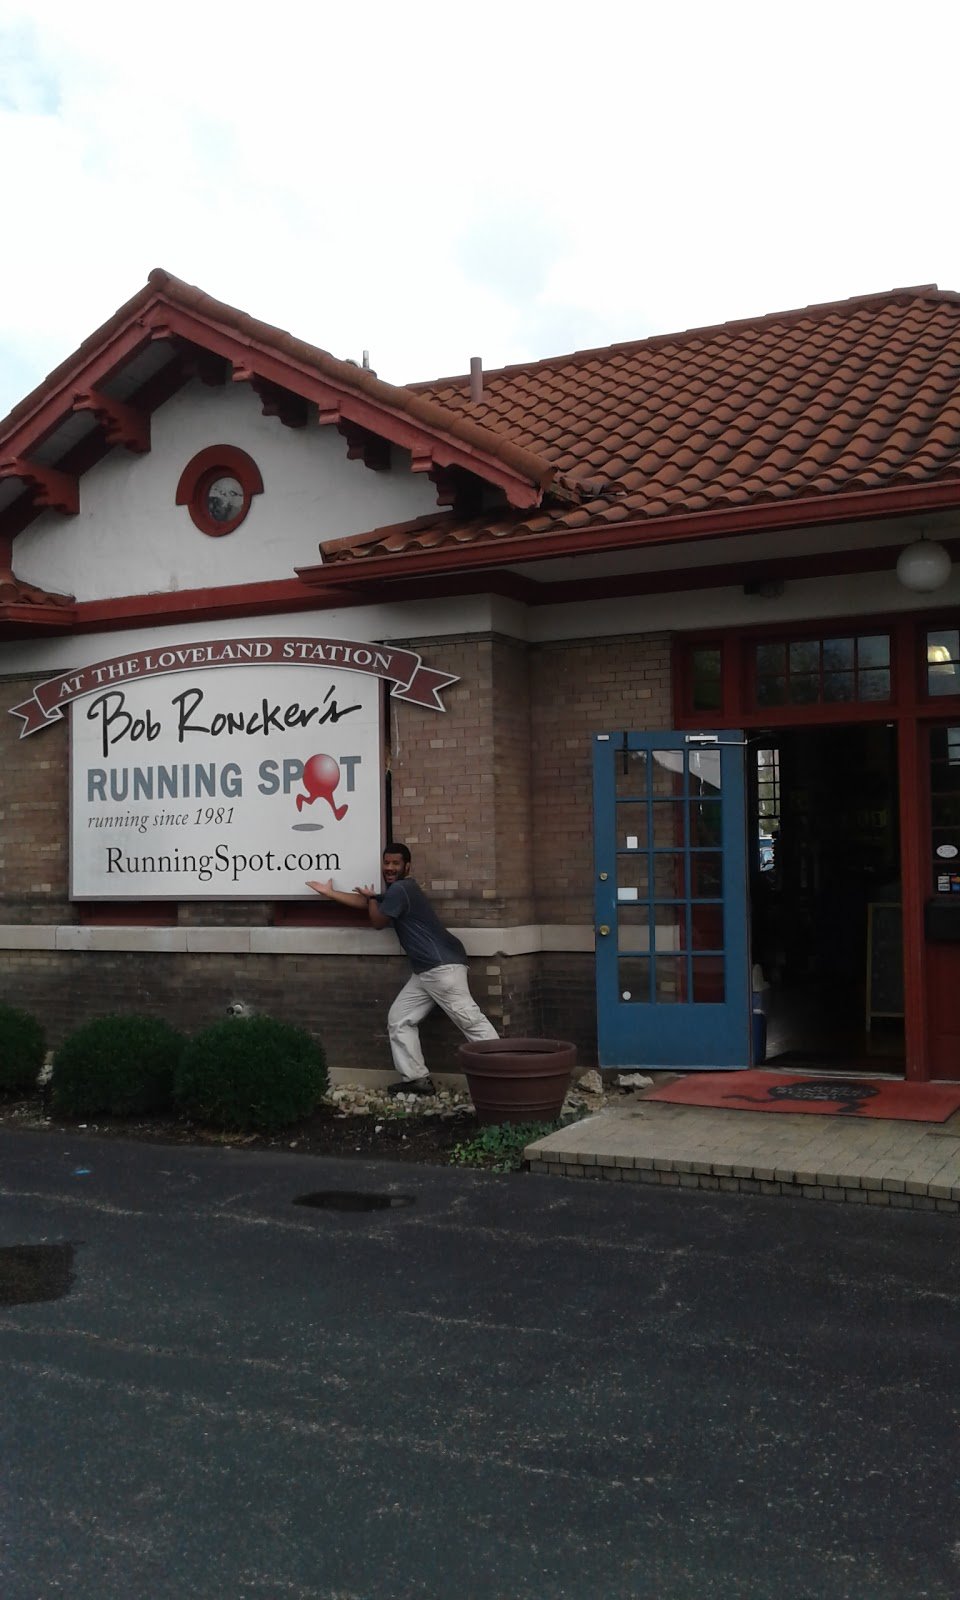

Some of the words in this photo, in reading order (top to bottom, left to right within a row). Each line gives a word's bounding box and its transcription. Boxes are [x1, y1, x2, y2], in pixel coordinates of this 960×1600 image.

[59, 674, 84, 698] AT
[92, 659, 140, 683] THE
[144, 643, 273, 671] LOVELAND
[282, 642, 393, 670] STATION
[86, 690, 161, 758] Bob
[87, 762, 243, 802] RUNNING
[88, 810, 149, 834] running
[152, 809, 189, 827] since
[193, 806, 234, 825] 1981
[105, 844, 342, 882] RunningSpot.com
